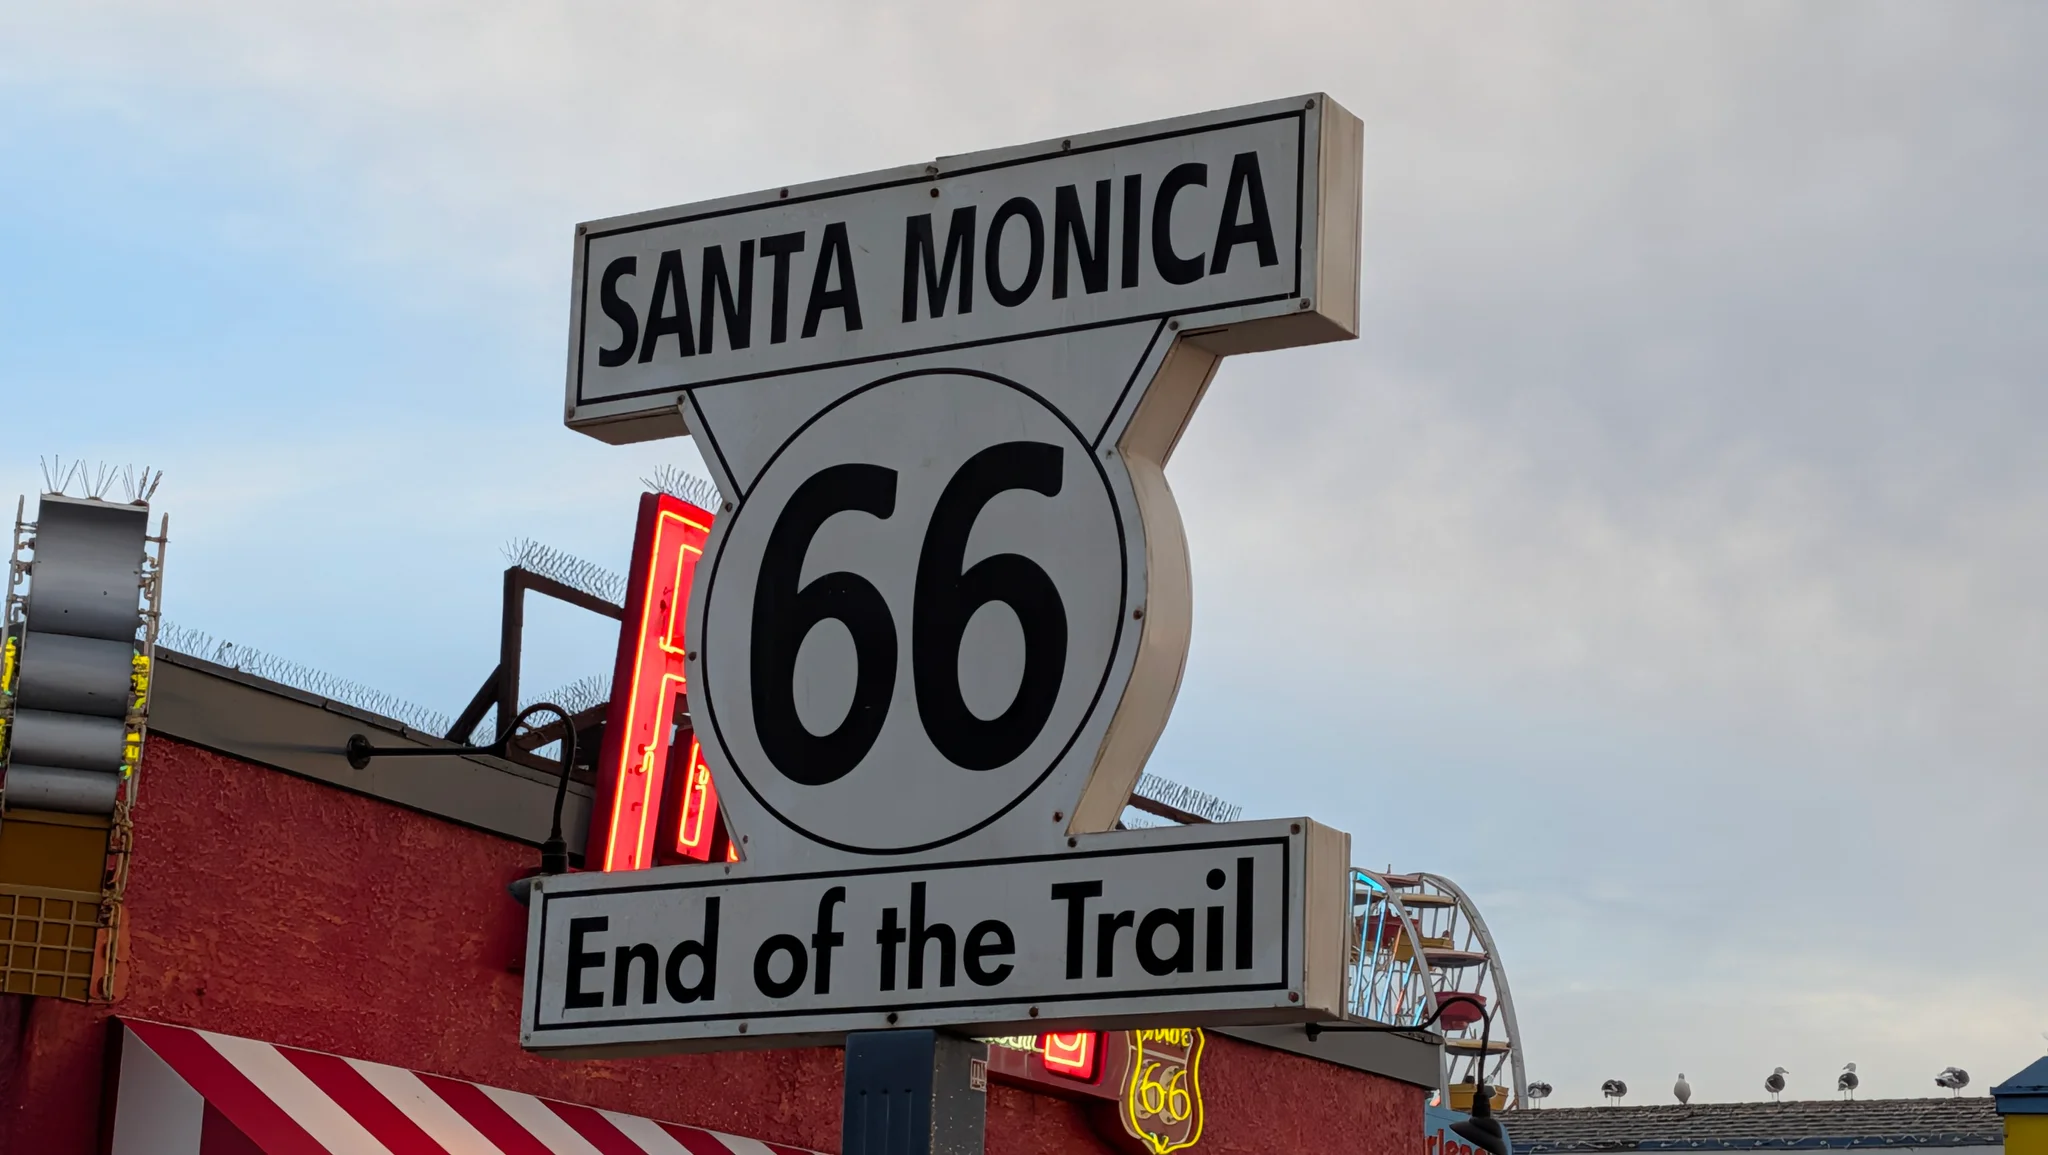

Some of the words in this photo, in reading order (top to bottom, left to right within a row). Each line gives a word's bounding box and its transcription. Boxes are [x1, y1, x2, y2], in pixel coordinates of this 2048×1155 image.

[598, 221, 864, 368] SANTA
[901, 150, 1280, 324] MONICA
[749, 440, 1069, 787] 66
[562, 895, 721, 1019] End
[752, 886, 847, 1000] of
[875, 880, 1016, 992] the
[1050, 856, 1255, 981] Trail
[1137, 1060, 1191, 1123] 66
